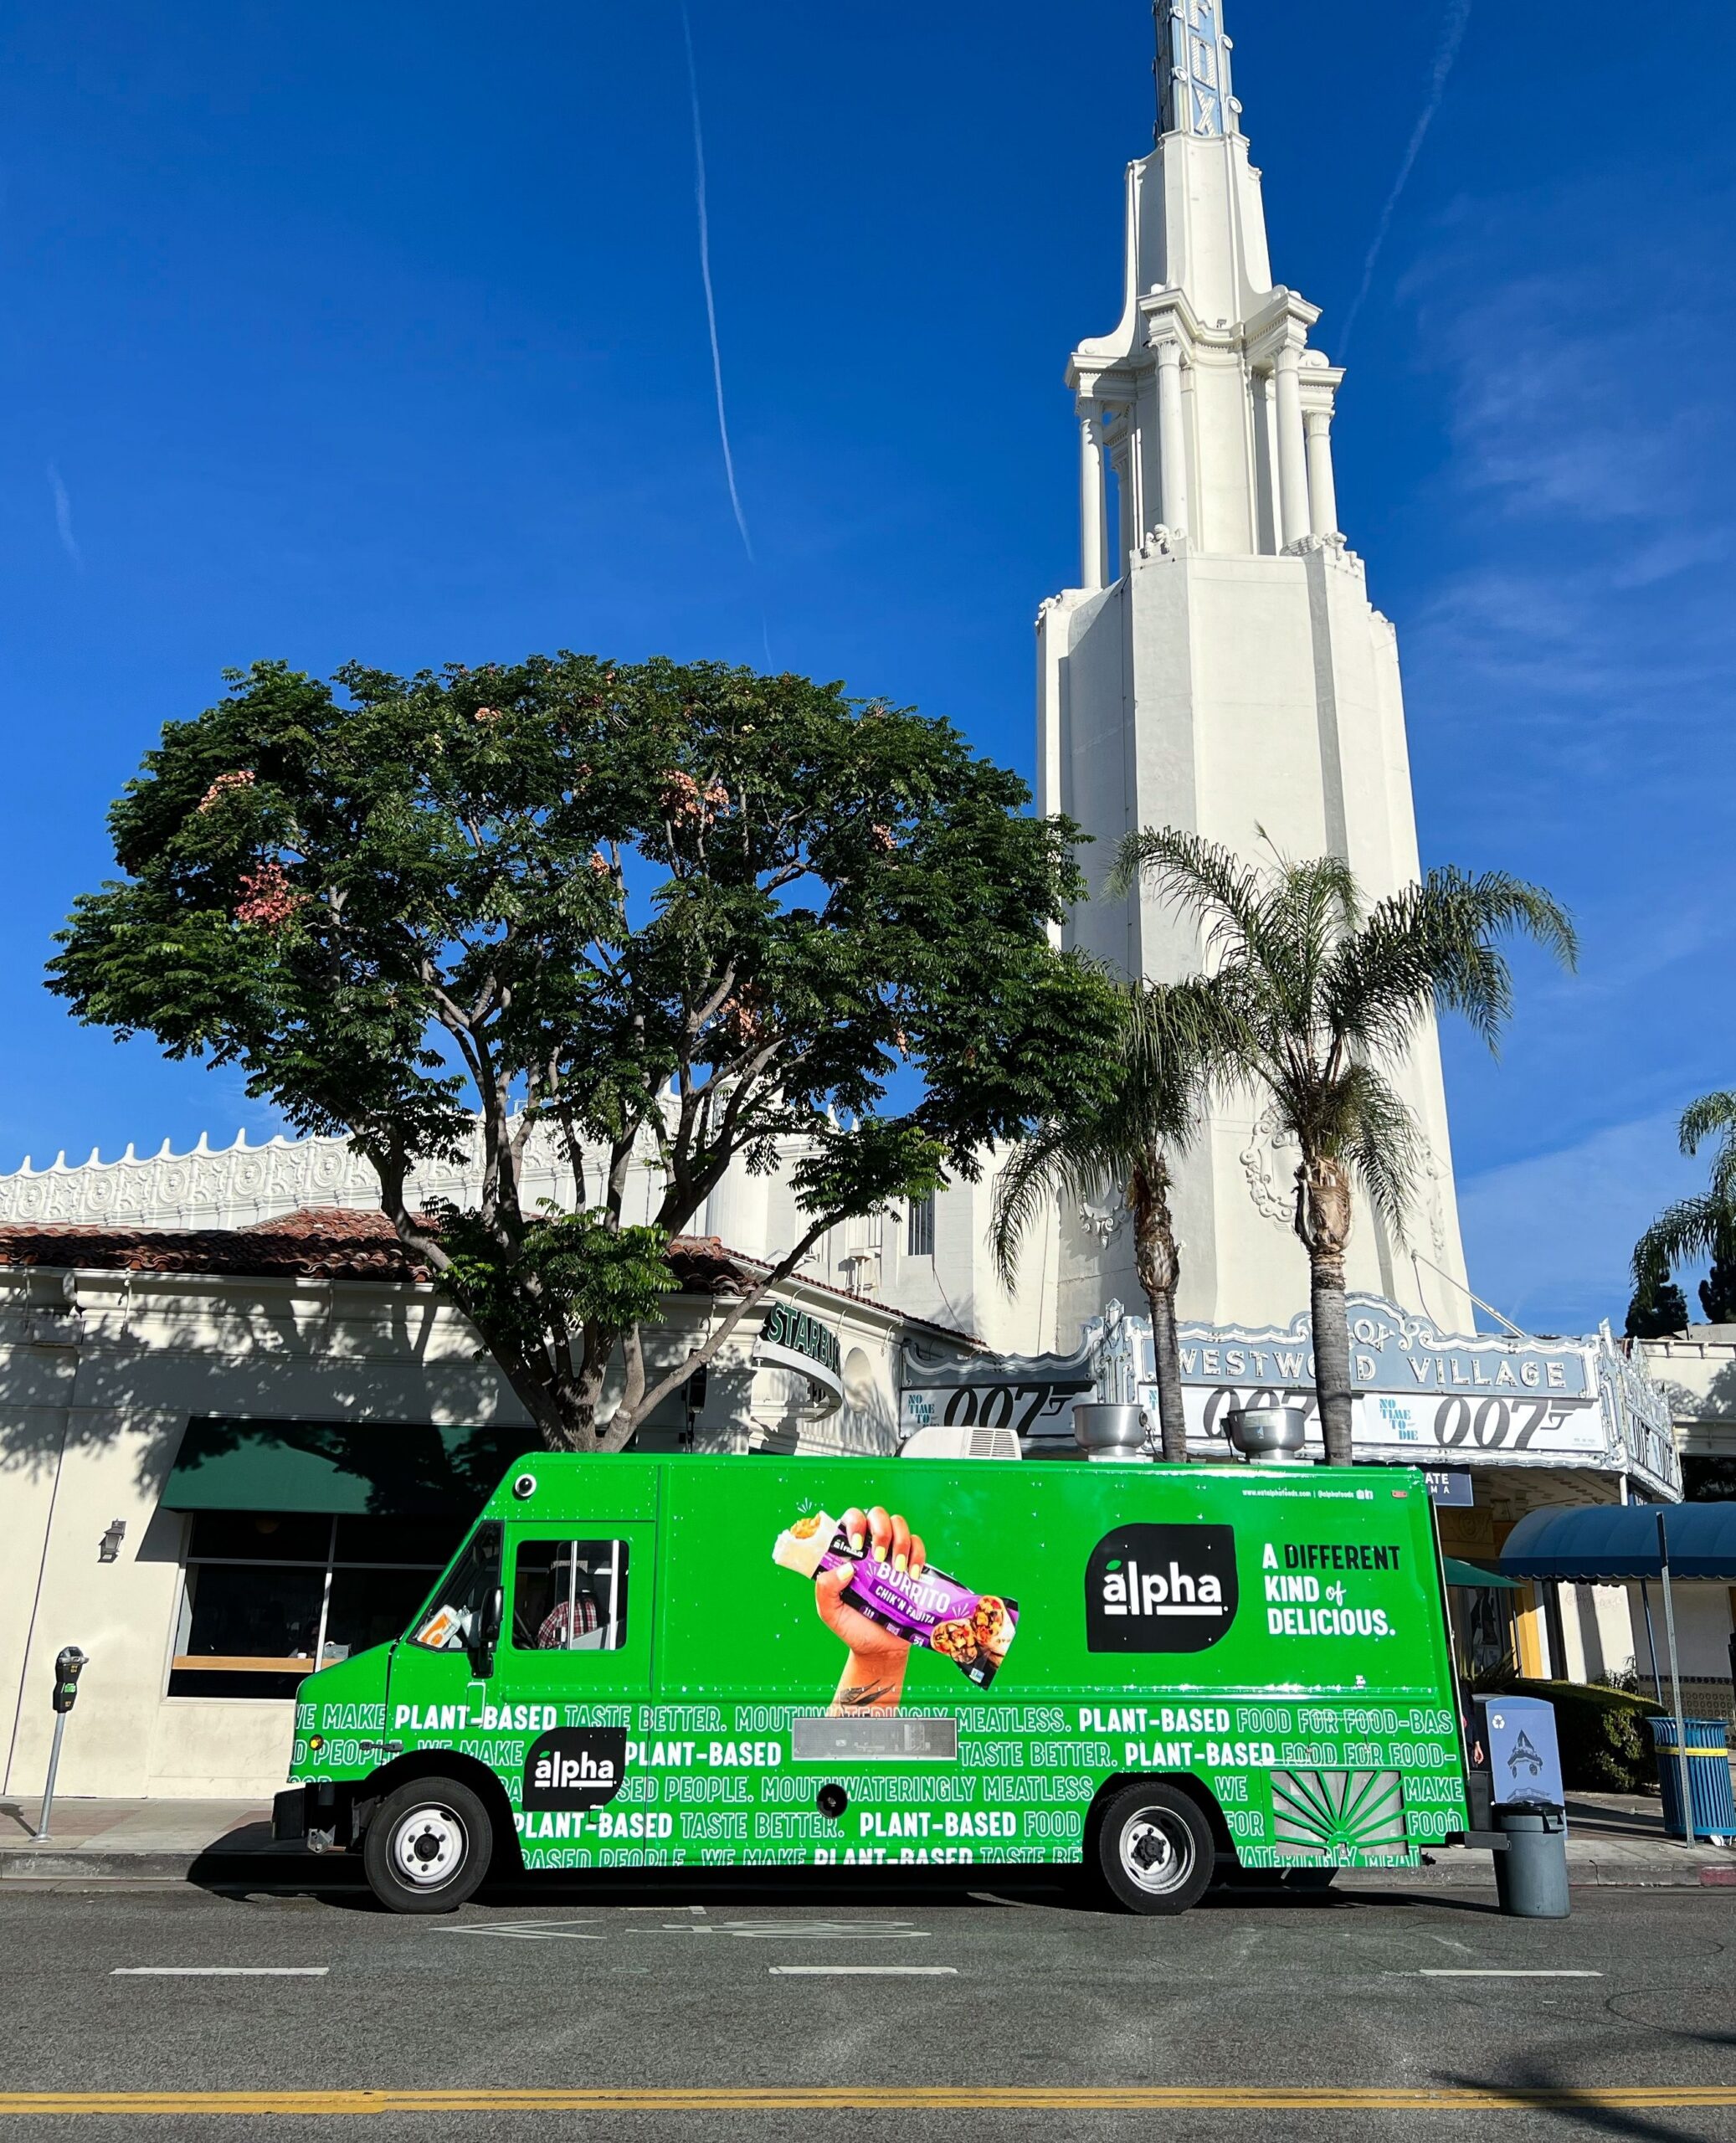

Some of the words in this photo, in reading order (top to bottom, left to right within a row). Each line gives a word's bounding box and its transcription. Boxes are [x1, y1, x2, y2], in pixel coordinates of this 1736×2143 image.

[1179, 1349, 1376, 1381] WESTWD
[1407, 1356, 1566, 1389] VILLAGE
[908, 1394, 923, 1405] NO
[908, 1403, 935, 1414] TIME
[1379, 1399, 1396, 1409] NO
[916, 1413, 930, 1424] TO
[1379, 1409, 1411, 1420] TIME
[1389, 1420, 1406, 1430] TO
[1434, 1397, 1550, 1449] 007
[1399, 1430, 1419, 1441] DIE
[1425, 1473, 1449, 1485] ATE
[1262, 1544, 1279, 1570] A
[1284, 1544, 1400, 1570] DIFFERENT
[876, 1562, 951, 1614] BURRITO
[1102, 1560, 1223, 1616] alpha
[1264, 1575, 1321, 1602] KIND
[1325, 1580, 1348, 1606] of
[1267, 1608, 1396, 1637] DELICIOUS.
[322, 1704, 386, 1729] MAKE
[394, 1704, 557, 1731] PLANT-BASED
[565, 1705, 632, 1732] TASTE
[639, 1706, 727, 1732] BETTER.
[957, 1708, 1071, 1733] MEATLESS.
[1079, 1708, 1230, 1733] PLANT-BASED
[1236, 1709, 1292, 1734] FOOD
[1299, 1709, 1338, 1734] FOR
[625, 1741, 783, 1767] PLANT-BASED
[960, 1742, 1027, 1767] TASTE
[1031, 1742, 1118, 1767] BETTER.
[1125, 1742, 1276, 1767] PLANT-BASED
[1281, 1743, 1338, 1767] FOOD
[1343, 1744, 1384, 1767] FOR
[534, 1750, 615, 1788] alpha
[665, 1776, 755, 1802] PEOPLE.
[1215, 1776, 1248, 1801] WE
[1404, 1776, 1463, 1802] MAKE
[681, 1812, 747, 1838] TASTE
[755, 1812, 845, 1838] BETTER.
[860, 1812, 1016, 1837] PLANT-BASED
[1024, 1811, 1081, 1837] FOOD
[1224, 1811, 1265, 1837] FOR
[1407, 1811, 1465, 1837] FOOD
